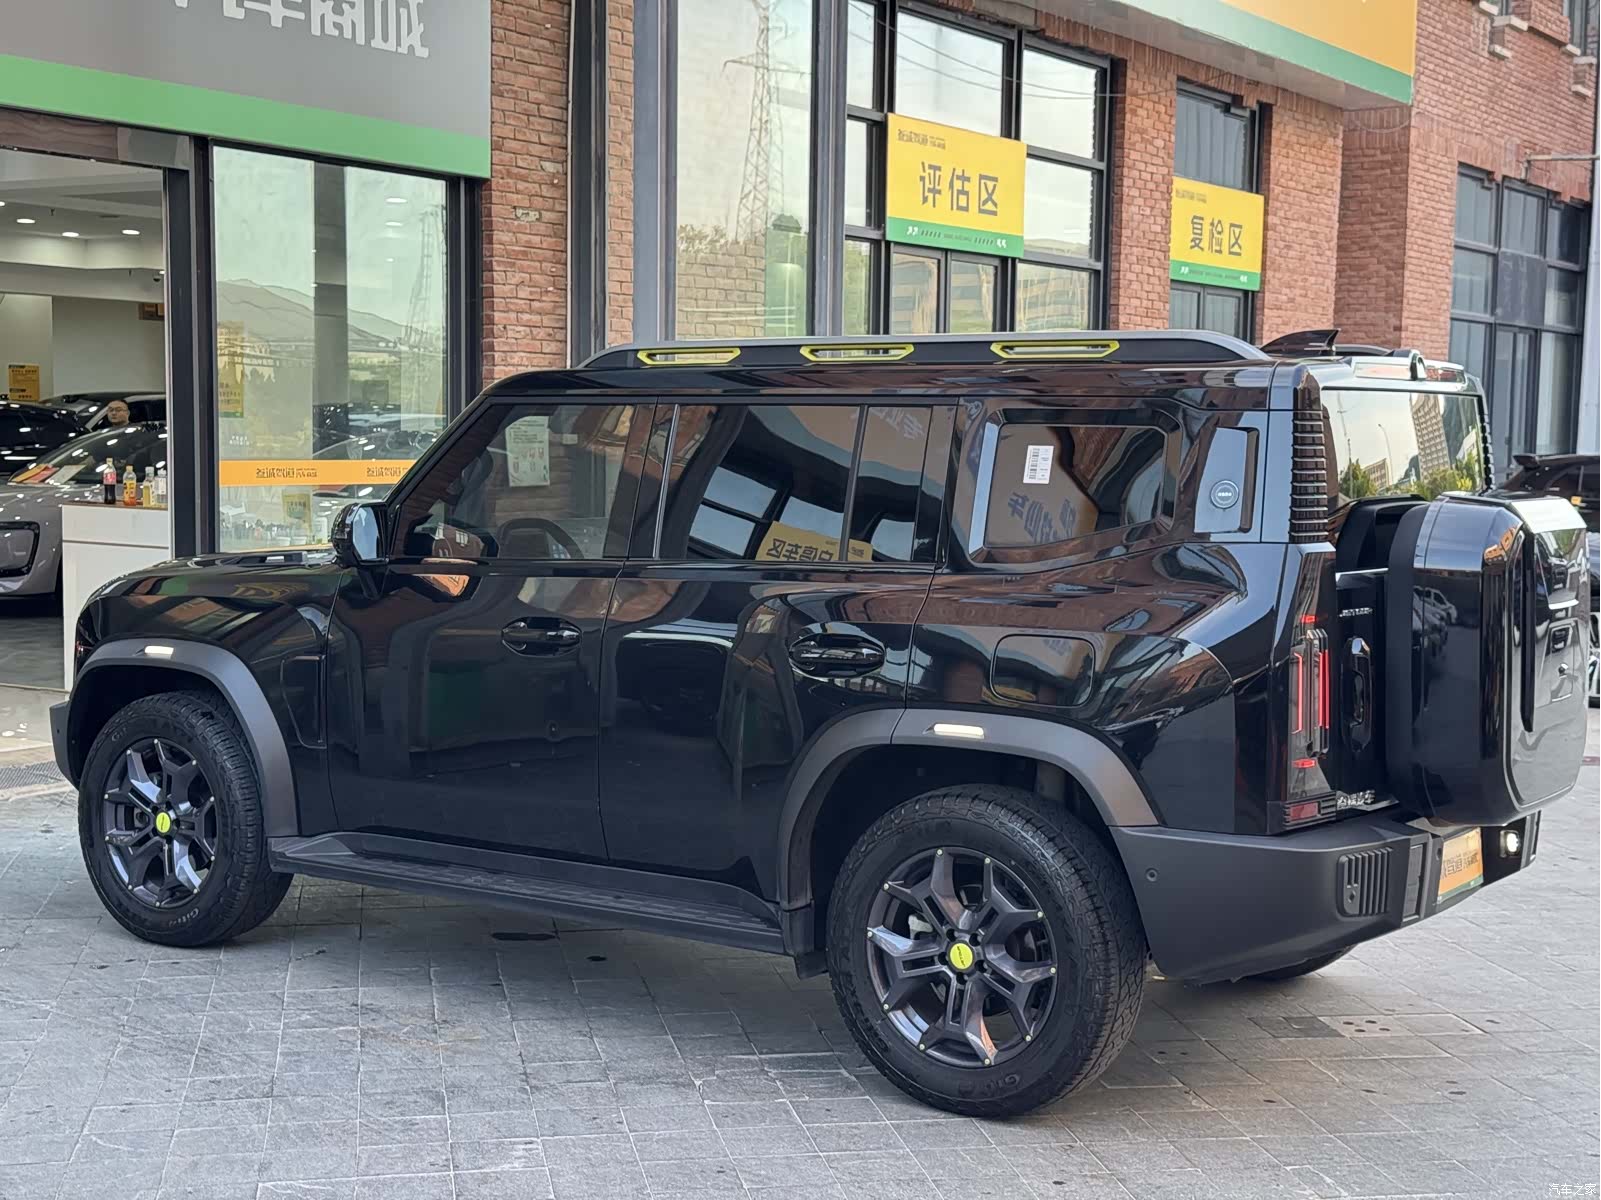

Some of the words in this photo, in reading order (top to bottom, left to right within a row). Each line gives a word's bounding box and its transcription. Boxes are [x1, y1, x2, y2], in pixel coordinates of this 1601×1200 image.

[919, 161, 999, 217] 评估区
[1189, 215, 1243, 256] 复检区
